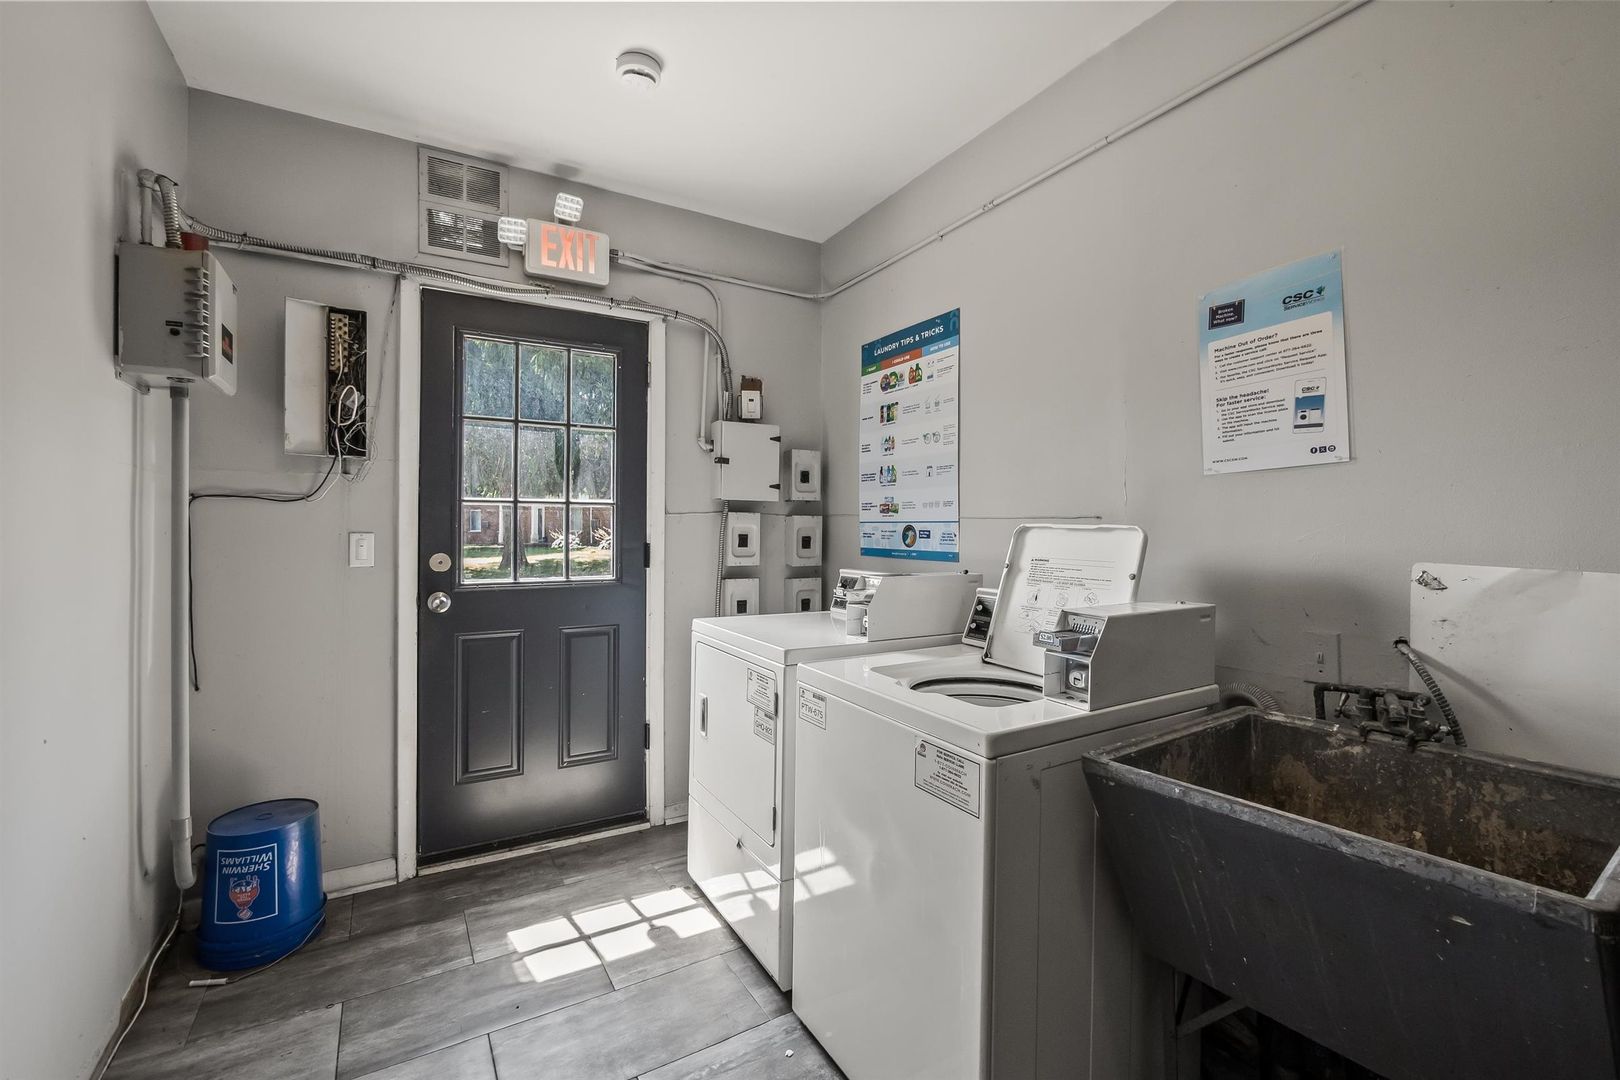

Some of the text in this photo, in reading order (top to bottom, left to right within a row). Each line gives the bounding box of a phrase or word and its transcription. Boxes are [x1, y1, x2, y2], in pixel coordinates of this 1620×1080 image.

[542, 224, 600, 274] EXIT
[1282, 290, 1314, 305] CSC
[874, 342, 899, 356] LAUNDRY
[900, 336, 914, 346] TIPS
[921, 326, 944, 339] TRICKS
[1257, 333, 1278, 342] Order?
[1240, 389, 1269, 398] headache!
[220, 852, 272, 865] WILLIAMS
[222, 861, 271, 874] SHERWIN
